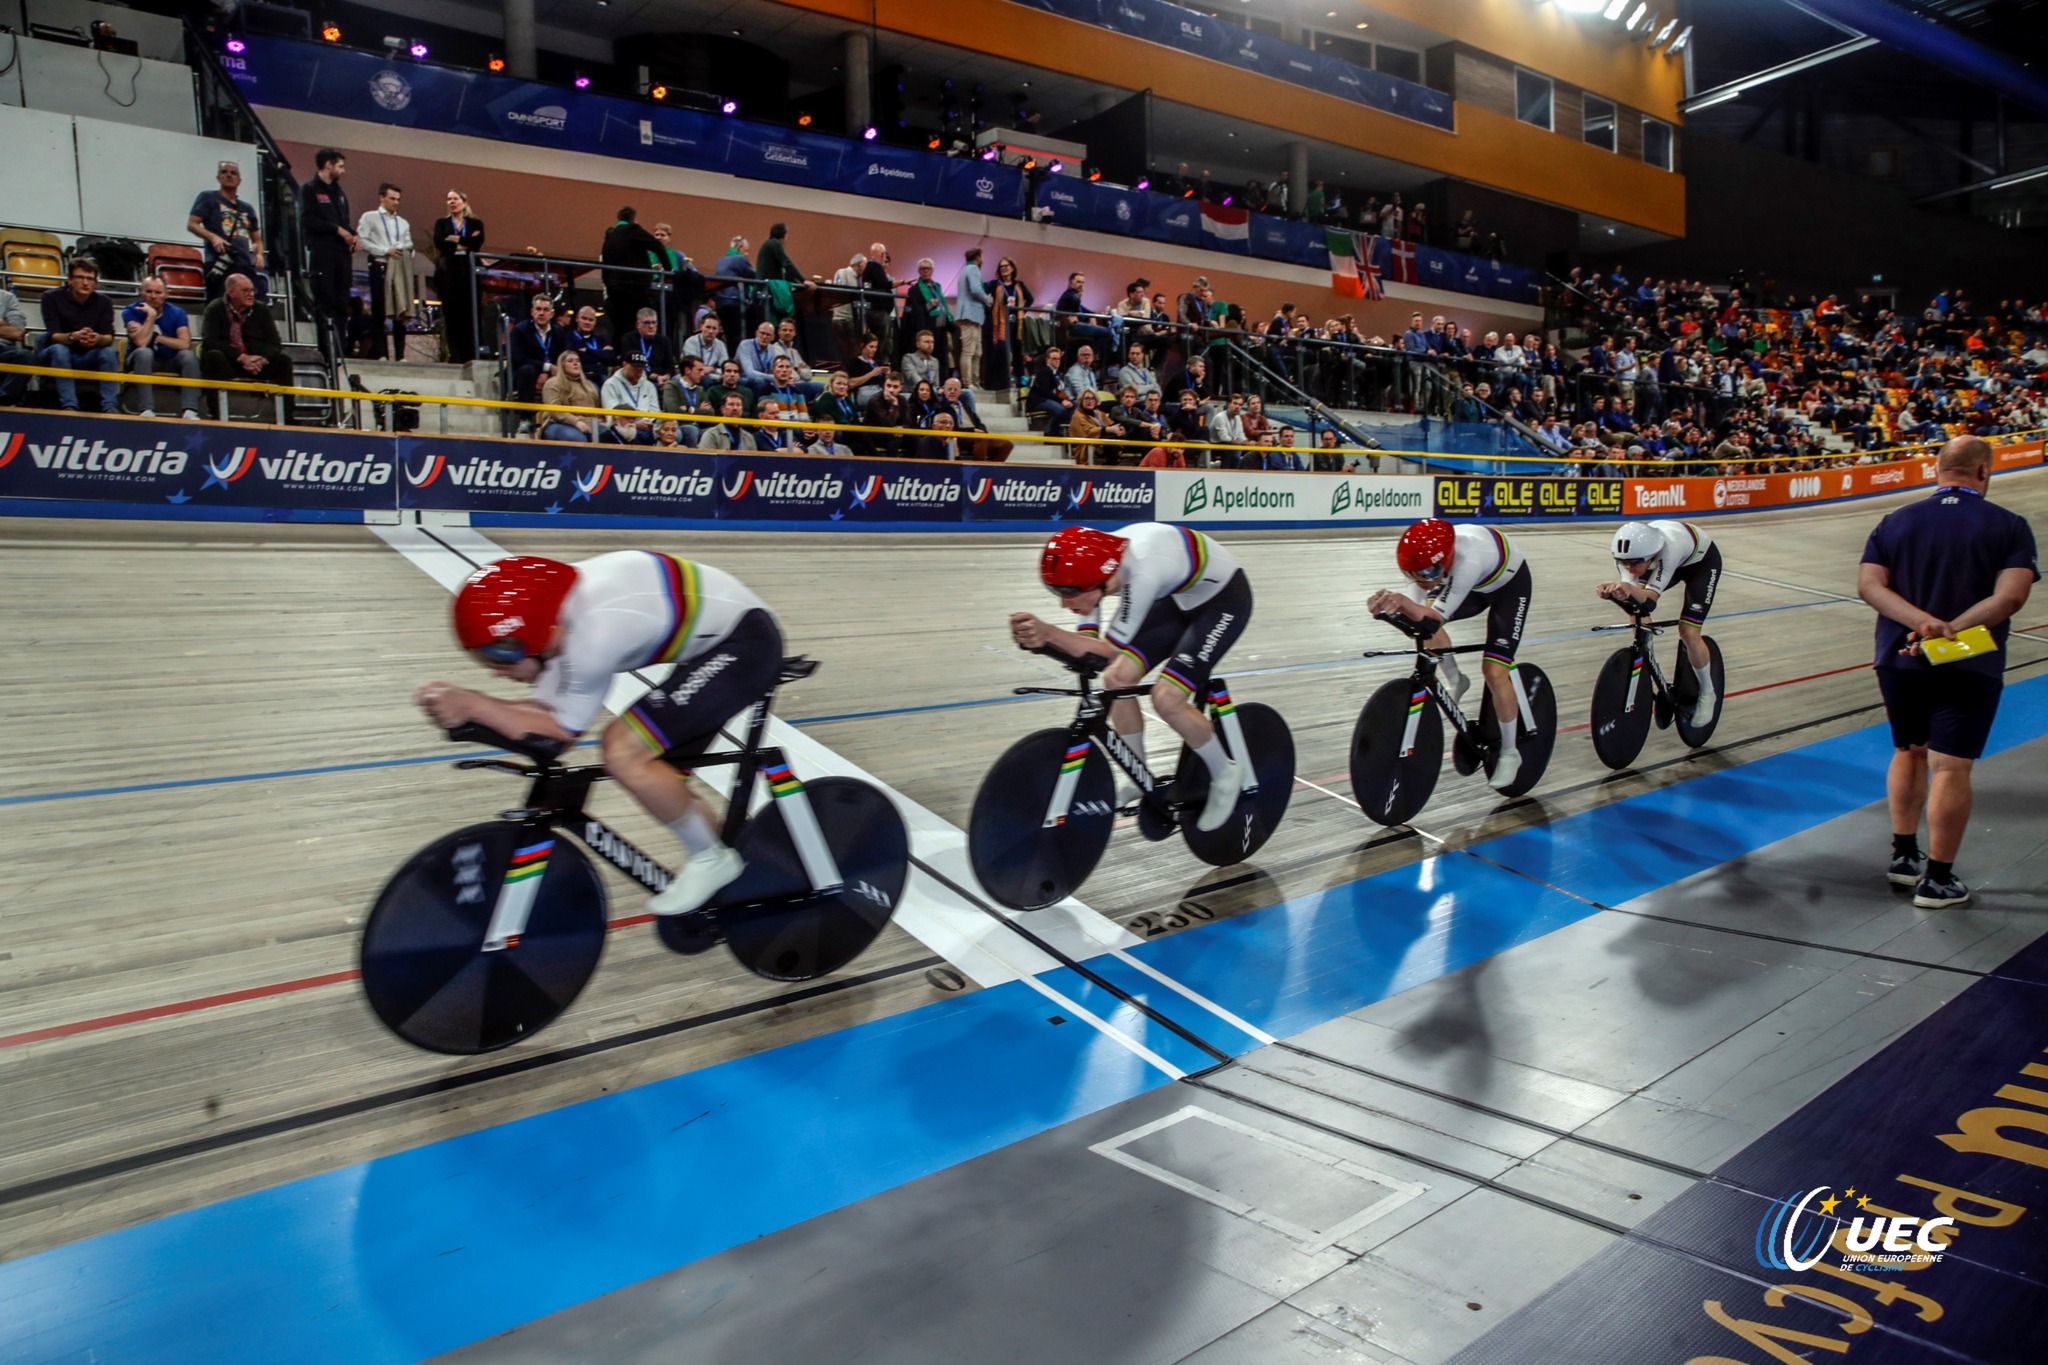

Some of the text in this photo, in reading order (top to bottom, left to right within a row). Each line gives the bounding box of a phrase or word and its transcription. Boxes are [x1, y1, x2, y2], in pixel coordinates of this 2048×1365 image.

[508, 111, 566, 128] OMNISPORT
[765, 152, 807, 166] Gelderland
[880, 167, 915, 179] Apeldoorn
[28, 435, 189, 475] vittoria
[259, 450, 392, 485] vittoria
[447, 457, 562, 490] vittoria
[613, 466, 714, 497] vittoria
[1921, 463, 1937, 480] Tea
[754, 472, 843, 499] vittoria
[882, 476, 960, 501] vittoria
[992, 479, 1062, 502] vittoria
[1092, 482, 1153, 504] vittoria
[1634, 484, 1686, 508] TeamNL
[1726, 478, 1766, 492] NEDERLANDSE
[1213, 486, 1294, 513] Apeldoorn
[1355, 487, 1422, 512] Apeldoorn
[1705, 568, 1717, 605] postnord
[1511, 597, 1527, 640] postnord
[1197, 612, 1235, 662] postnord
[1130, 900, 1216, 937] 250
[924, 967, 967, 992] 0
